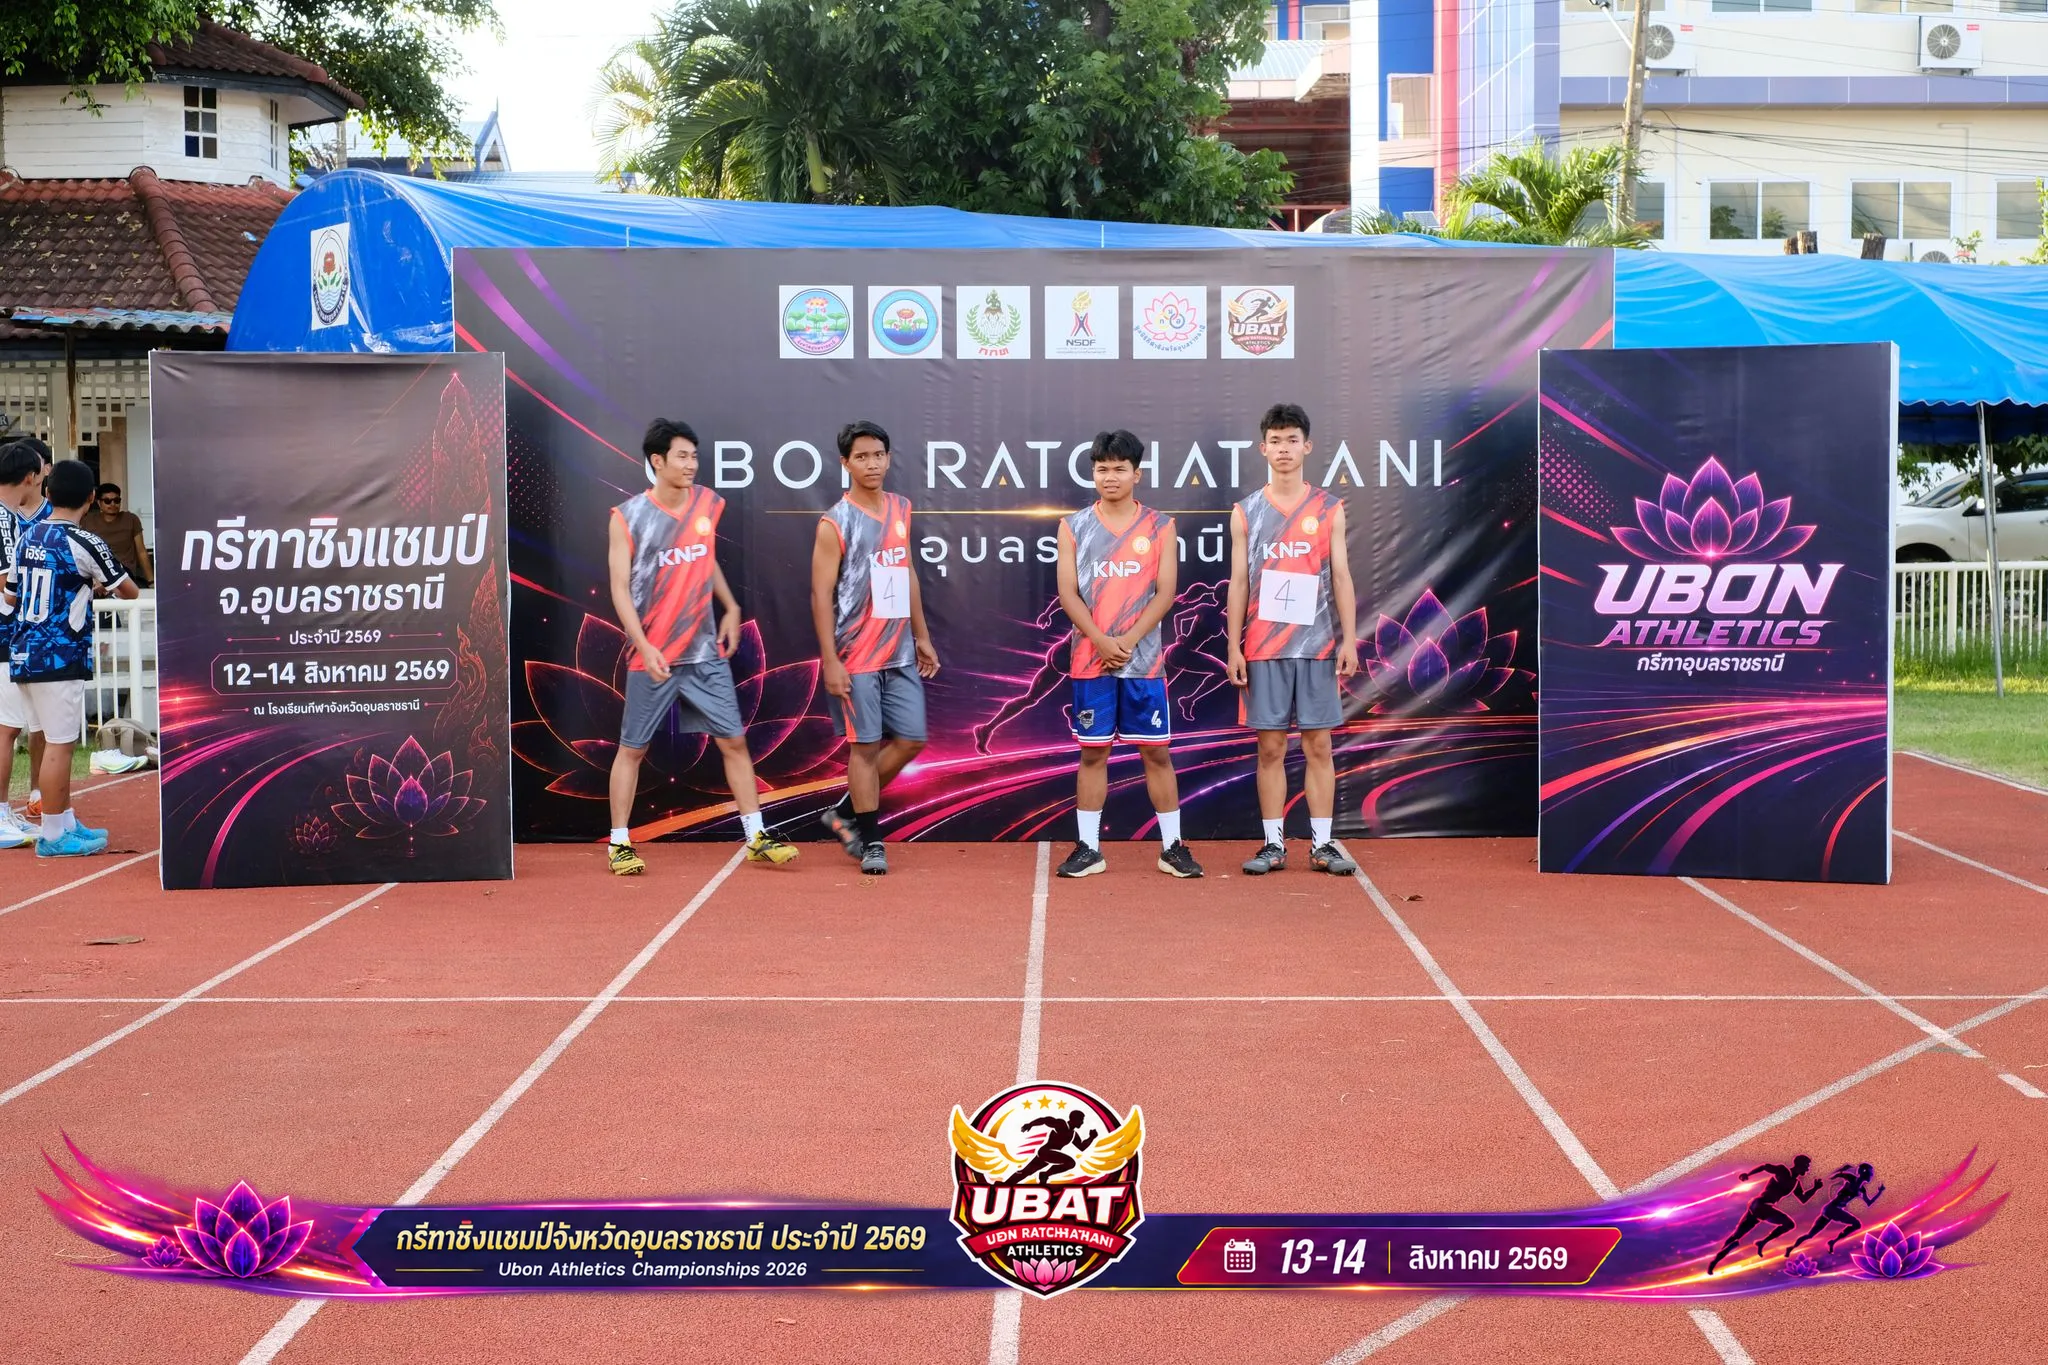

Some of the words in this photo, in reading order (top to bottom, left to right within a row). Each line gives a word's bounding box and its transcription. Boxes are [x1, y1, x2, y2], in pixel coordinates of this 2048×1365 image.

[1233, 322, 1284, 336] UBAT
[181, 513, 489, 571] กรีฑาชิงแชมป์
[1262, 541, 1311, 560] KNP
[658, 543, 708, 567] KNP
[869, 546, 907, 568] KNP
[1093, 560, 1141, 578] KNP
[17, 565, 53, 624] 10
[219, 573, 445, 625] จ.อุบลราชธานี
[883, 575, 896, 609] 4
[1274, 579, 1296, 611] 4
[1594, 564, 1846, 615] UBON
[289, 629, 340, 645] ประจำปี
[345, 629, 382, 644] 2569
[1594, 620, 1834, 647] ATHLETICS
[304, 660, 387, 684] สิงหาคม
[395, 659, 450, 681] 2569
[253, 705, 265, 716] ณ
[1151, 710, 1162, 728] 4
